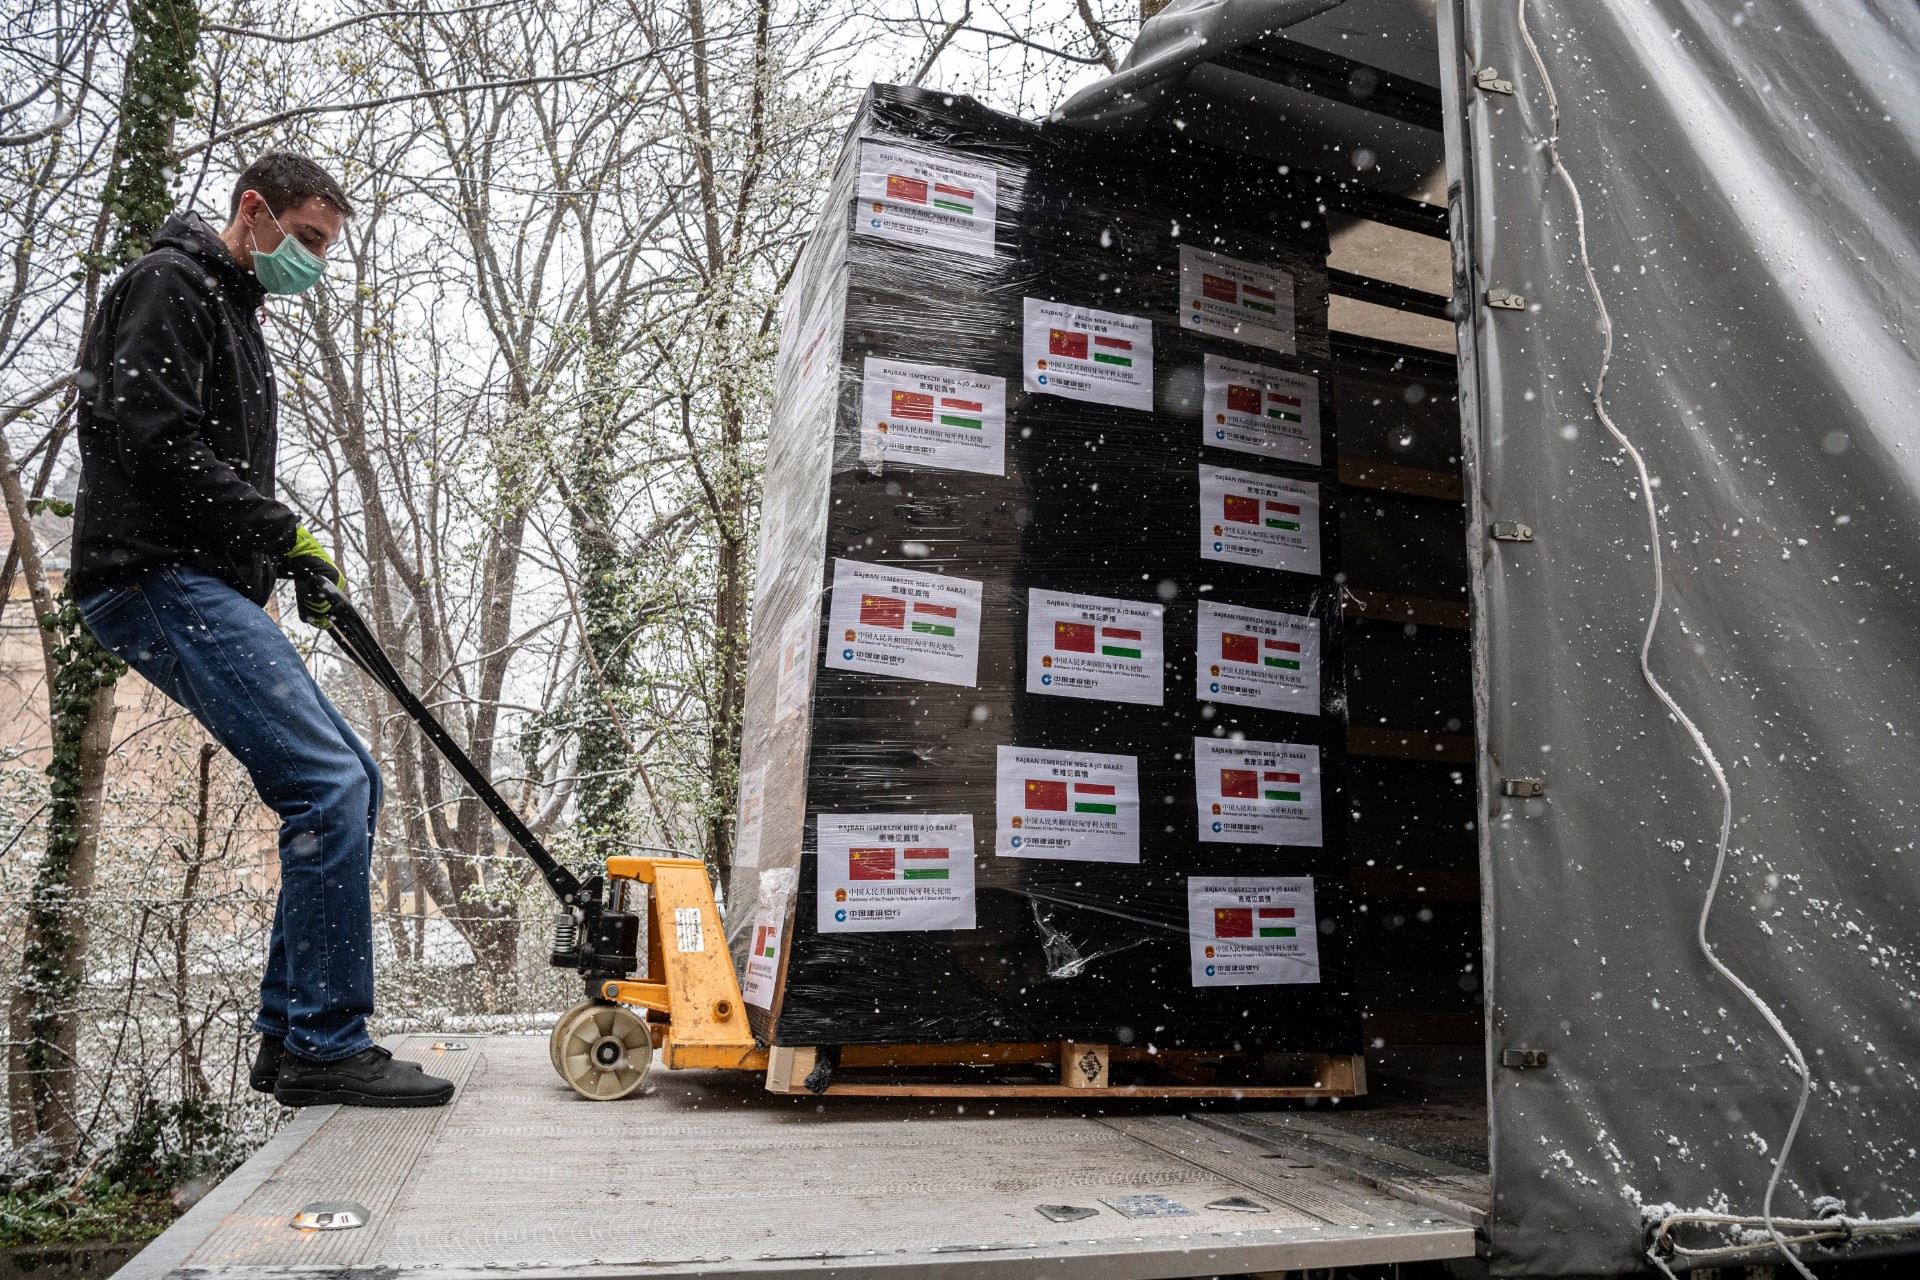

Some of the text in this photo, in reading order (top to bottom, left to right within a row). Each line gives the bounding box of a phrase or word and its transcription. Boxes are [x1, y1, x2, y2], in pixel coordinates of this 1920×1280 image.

[1072, 603, 1101, 611] ISMERSZIK
[1131, 609, 1149, 617] BARÁT
[1042, 759, 1073, 767] ISMERSZIK
